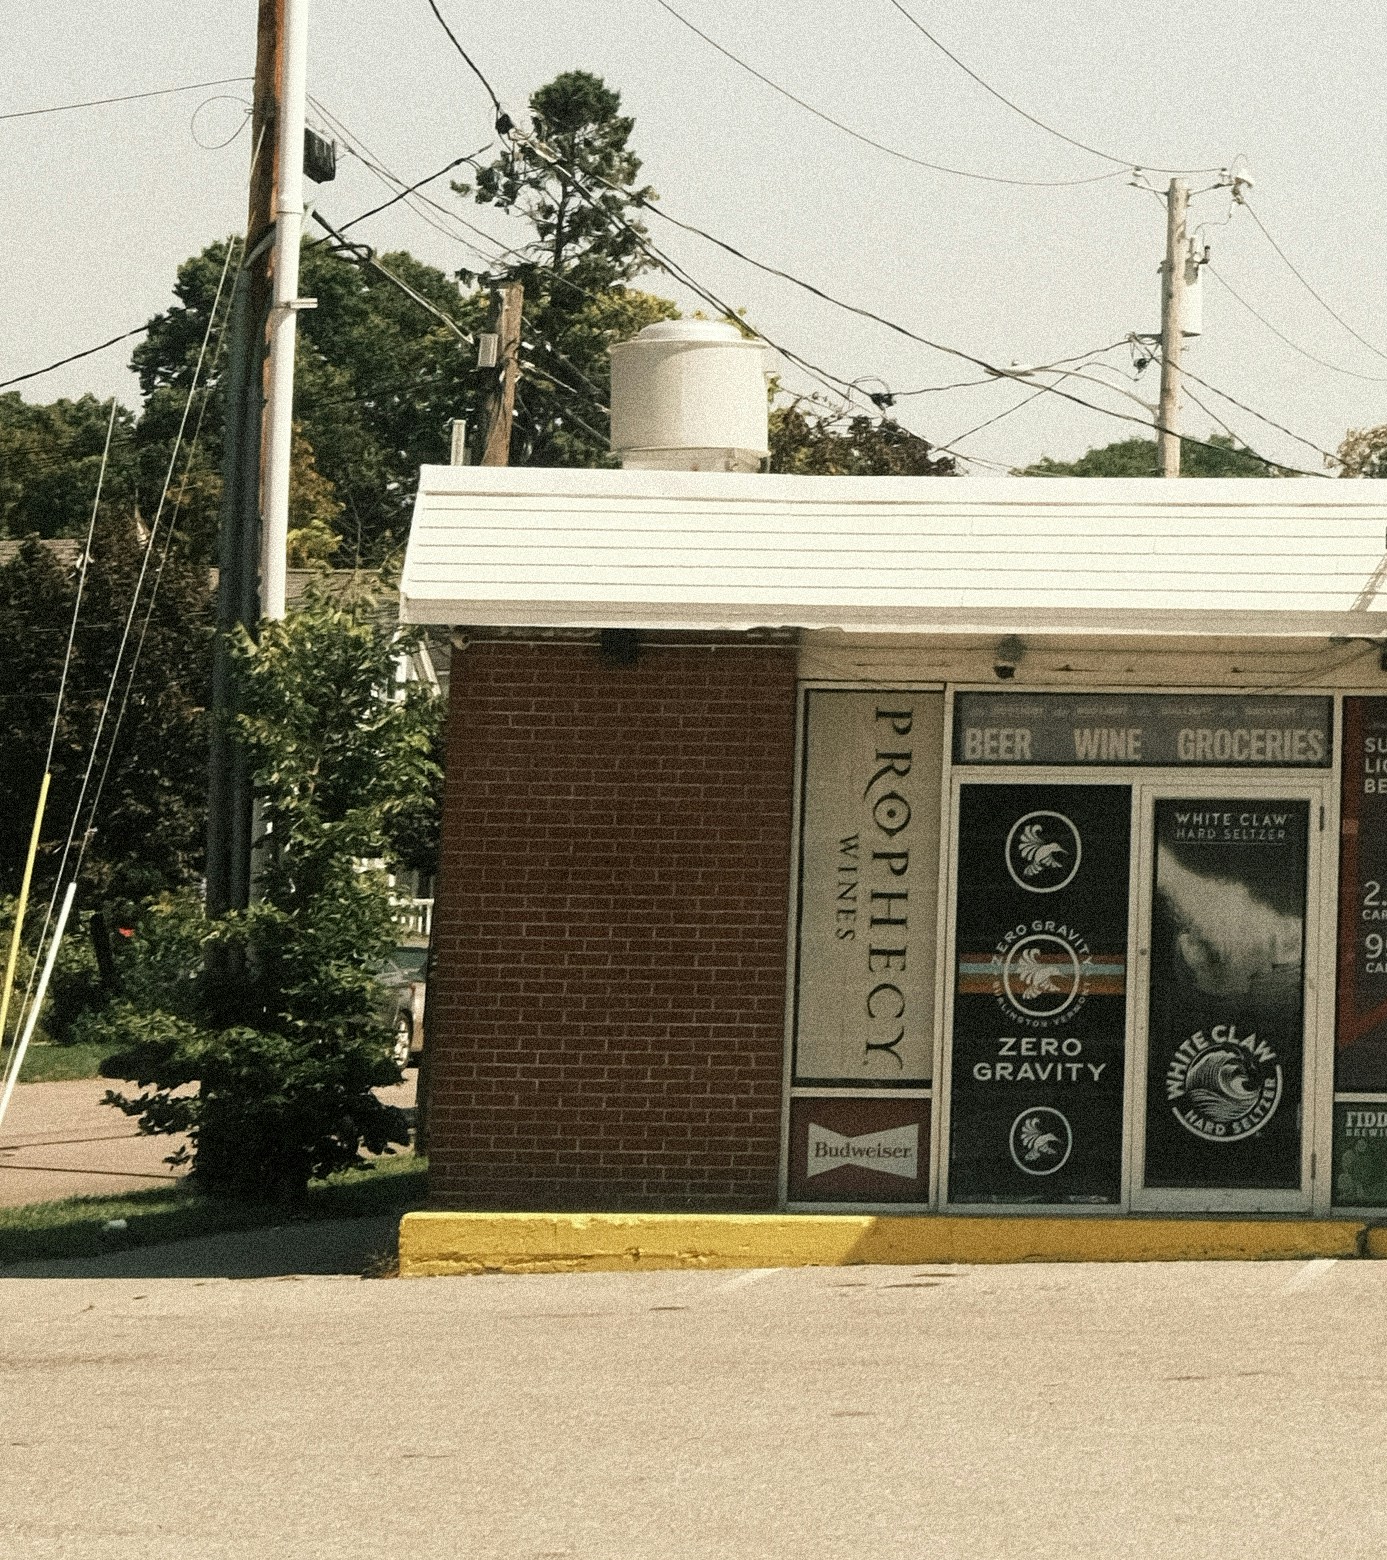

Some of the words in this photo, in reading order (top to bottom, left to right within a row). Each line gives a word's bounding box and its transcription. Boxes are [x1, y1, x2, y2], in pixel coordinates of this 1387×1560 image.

[964, 728, 1032, 760] BEER
[1073, 729, 1142, 760] WINE
[1177, 730, 1326, 762] GROCERIES
[1175, 813, 1231, 825] WHITE
[1240, 813, 1288, 826] CLAW
[1176, 829, 1217, 840] HARD
[1224, 829, 1286, 840] SELTZER
[837, 833, 859, 941] WINES
[864, 707, 914, 1070] PROPHECY
[992, 924, 1028, 967] ZERO
[1031, 920, 1094, 967] GRAVITY
[998, 1037, 1082, 1056] ZERO
[1166, 1030, 1209, 1100] WHITE
[1211, 1025, 1276, 1063] CLAW
[972, 1062, 1106, 1081] GRAVITY
[1184, 1109, 1226, 1135] HARD
[1232, 1078, 1276, 1134] SELTZER
[814, 1141, 913, 1161] Budweiser
